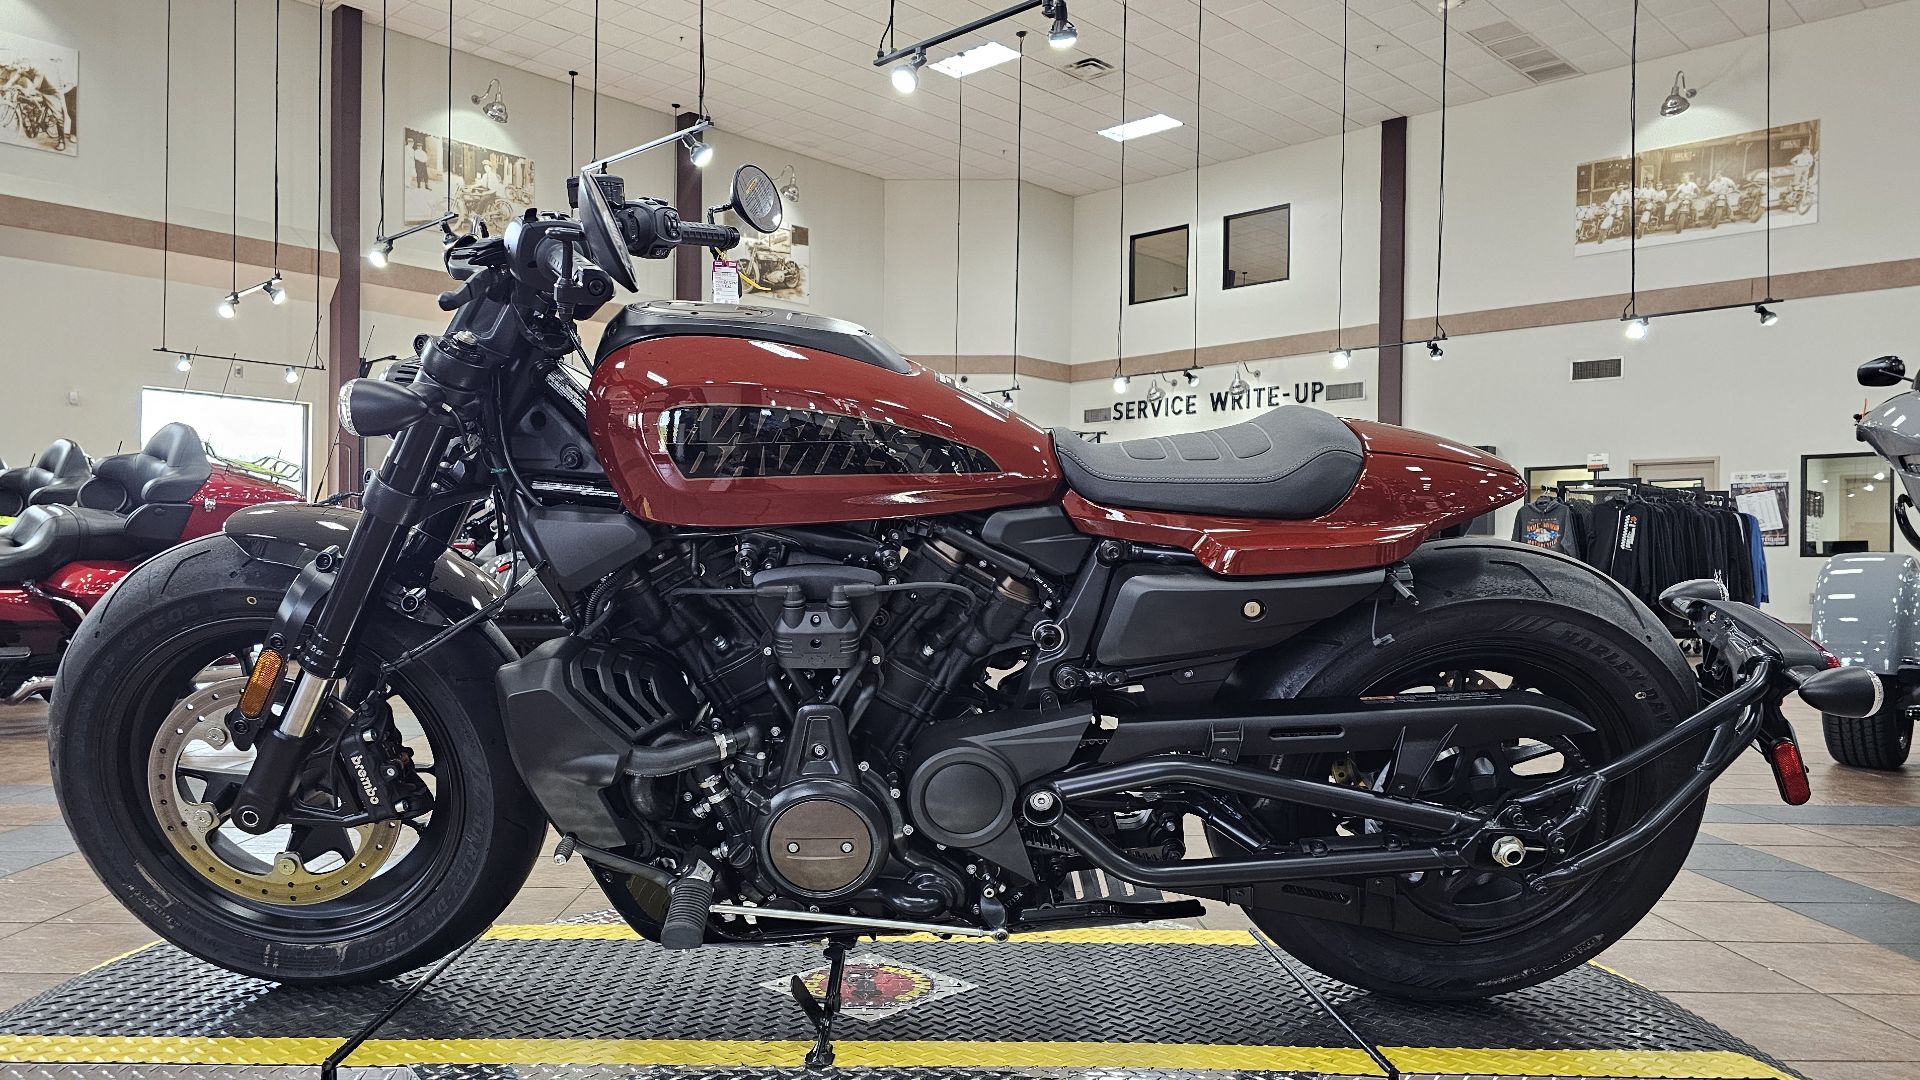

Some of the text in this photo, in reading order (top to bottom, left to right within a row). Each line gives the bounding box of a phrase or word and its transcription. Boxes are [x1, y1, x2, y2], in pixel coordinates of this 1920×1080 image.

[1113, 382, 1324, 420] SERVICE WRITE-UP
[1556, 629, 1673, 721] HARLEY-DAV
[350, 754, 380, 805] brembo
